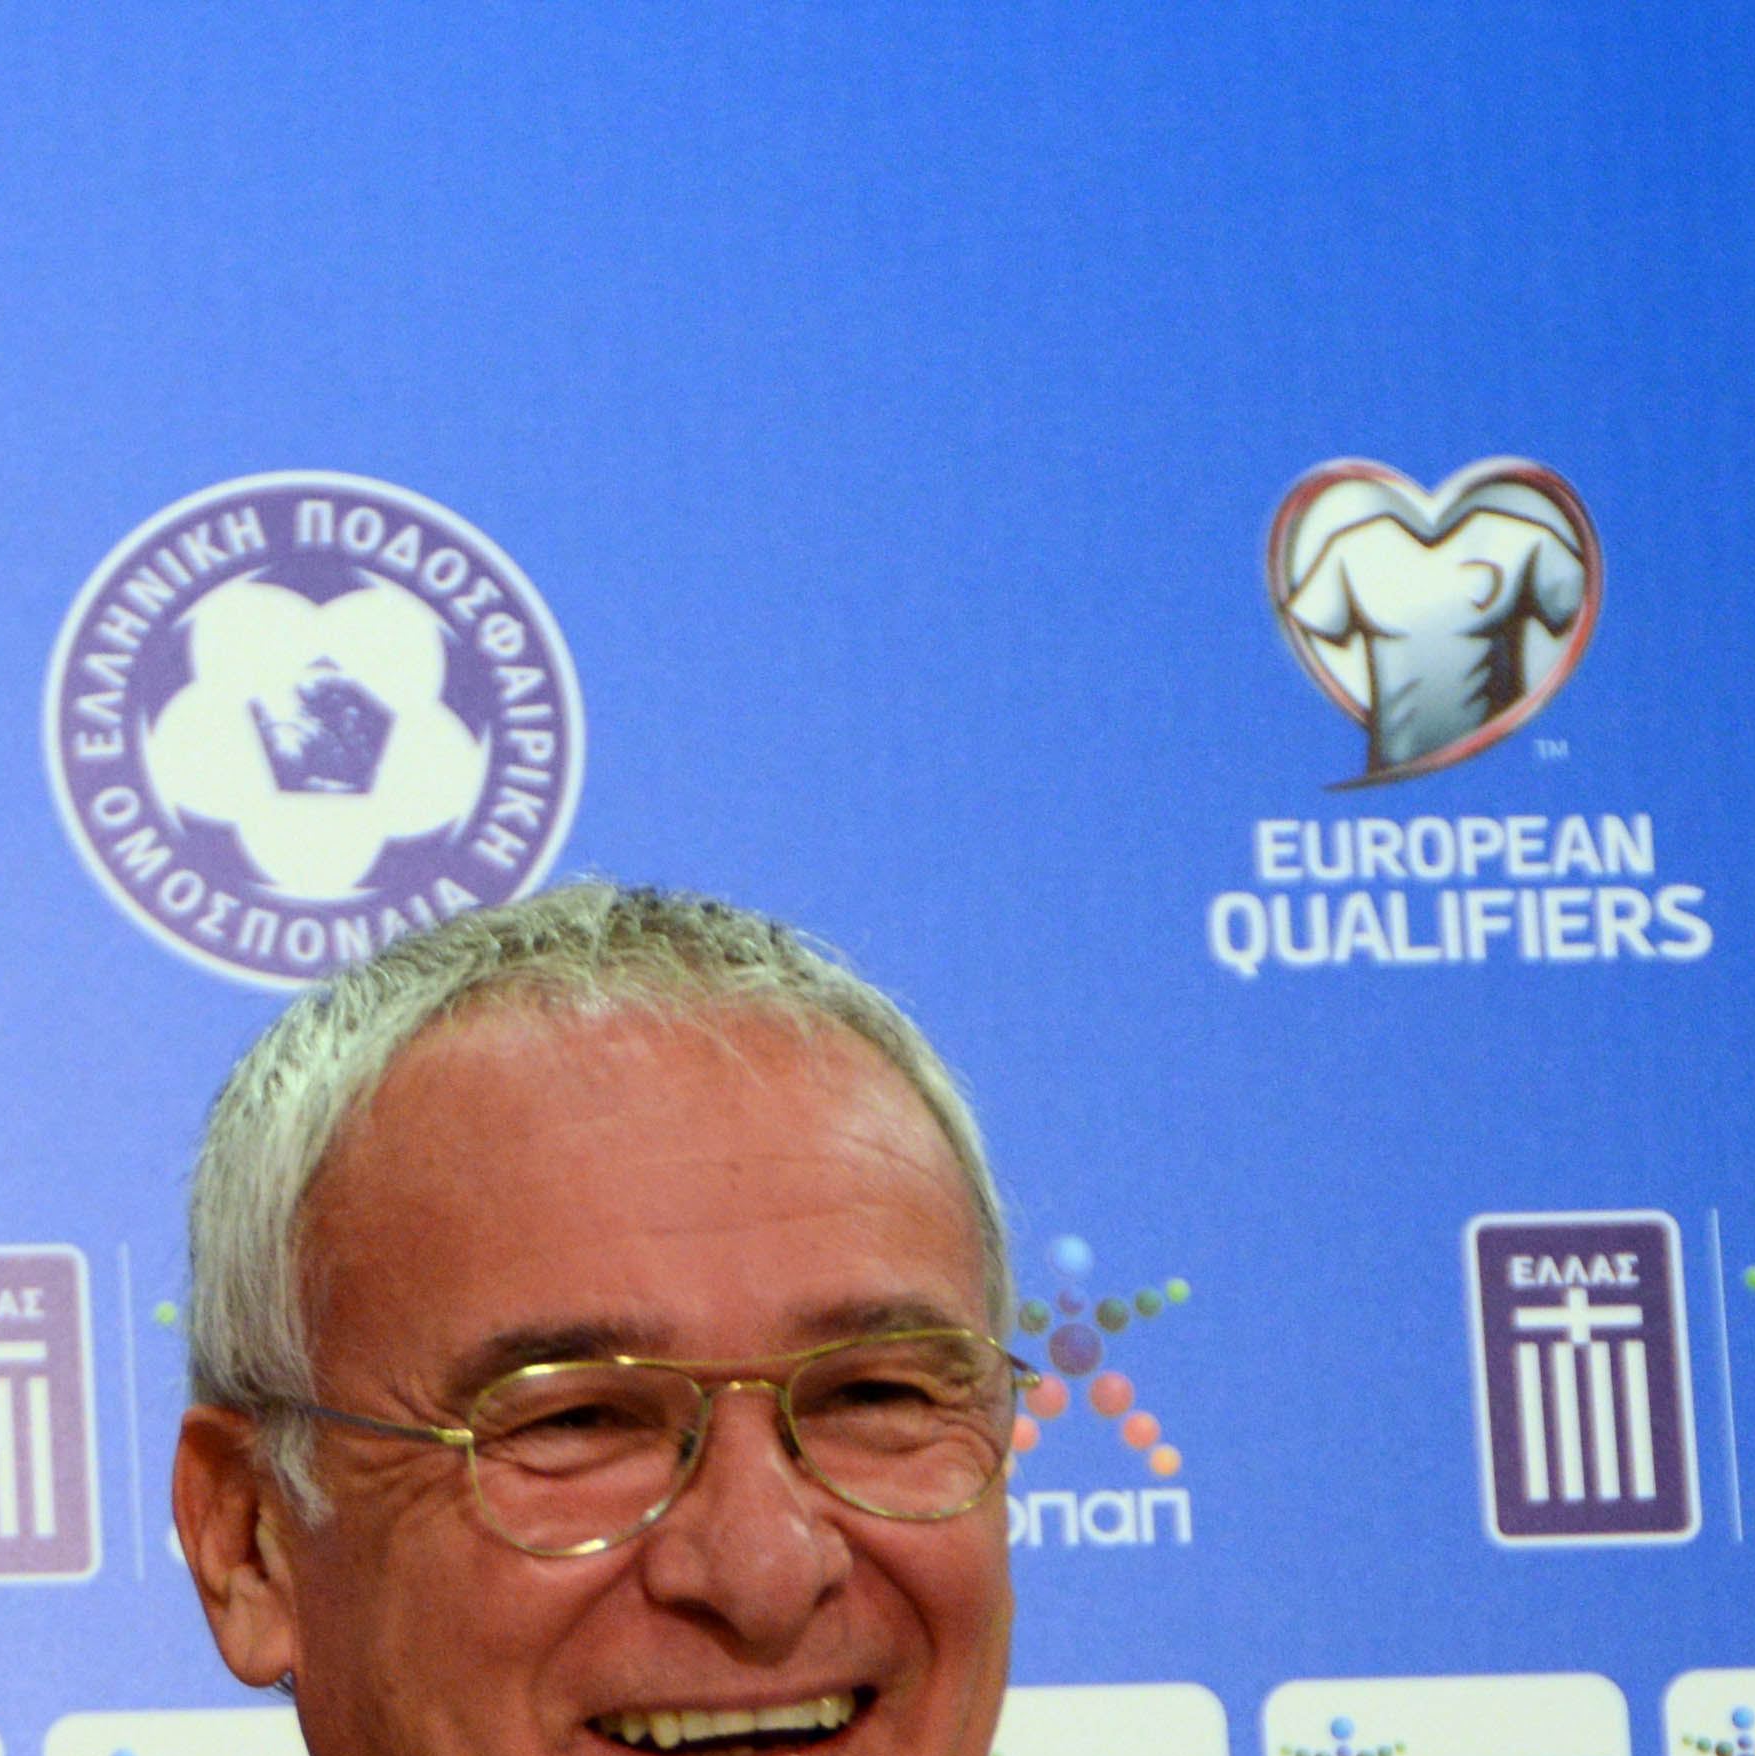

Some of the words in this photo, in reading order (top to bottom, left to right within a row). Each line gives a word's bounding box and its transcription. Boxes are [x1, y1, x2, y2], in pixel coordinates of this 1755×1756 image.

[74, 506, 268, 759] ΕΛΛΗΝΙΚΗ
[295, 499, 557, 870] ΠΟΔΟΣΦΑΙΡΙΚΗ
[1255, 813, 1656, 882] EUROPEAN
[1207, 883, 1714, 978] QUALIFIERS
[1508, 1253, 1639, 1288] ΕΛΛΑΣ
